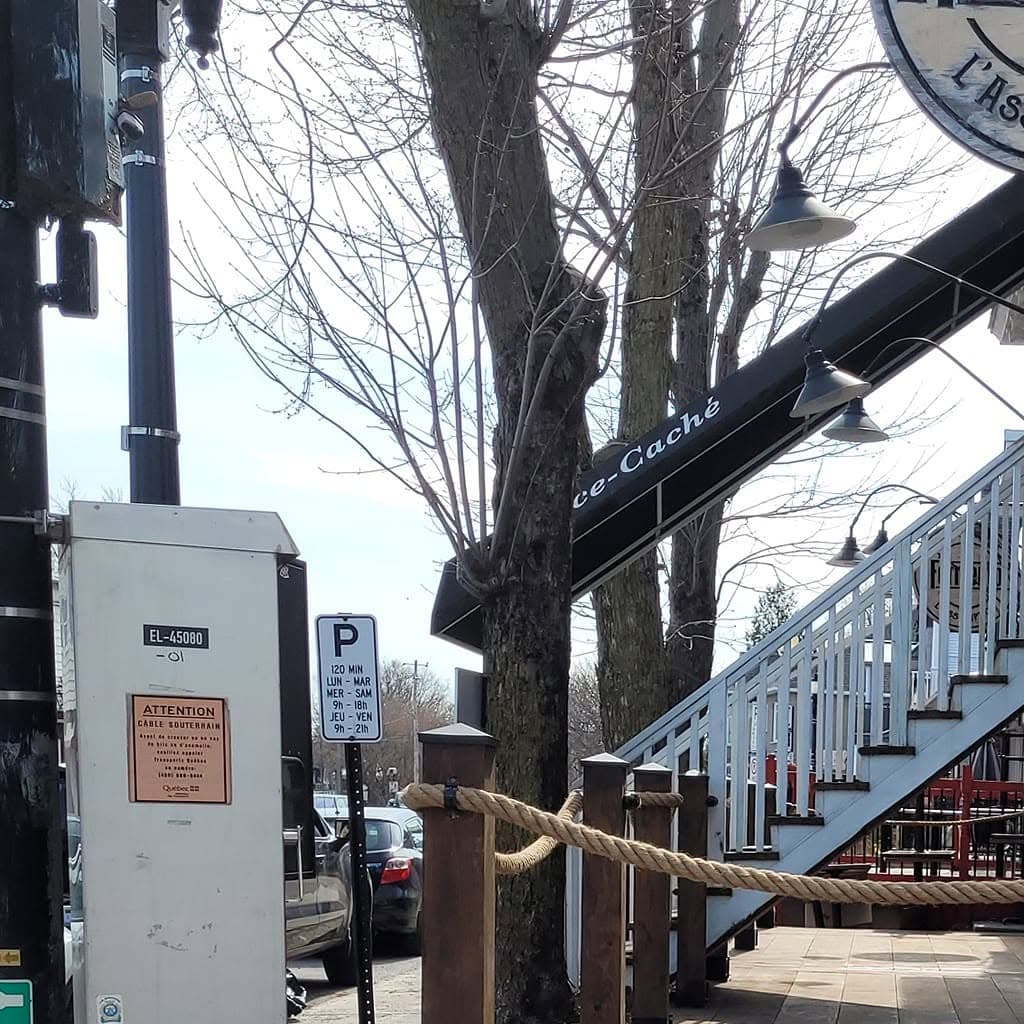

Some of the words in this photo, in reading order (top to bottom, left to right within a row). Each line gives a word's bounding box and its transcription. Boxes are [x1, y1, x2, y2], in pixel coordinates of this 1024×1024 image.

[572, 396, 721, 509] ce-Caché
[150, 629, 203, 645] EL-45080
[333, 623, 359, 657] P
[331, 665, 345, 674] 120
[348, 664, 363, 674] MIN
[327, 677, 342, 686] LUN
[354, 677, 371, 686] MAR
[327, 689, 344, 698] MER
[355, 688, 372, 698] SAM
[333, 700, 343, 710] 9h
[354, 701, 368, 710] 18h
[143, 704, 215, 717] ATTENTION
[329, 712, 345, 722] JEU
[356, 712, 372, 721] VEN
[334, 724, 345, 733] 9h
[356, 724, 368, 733] 21h
